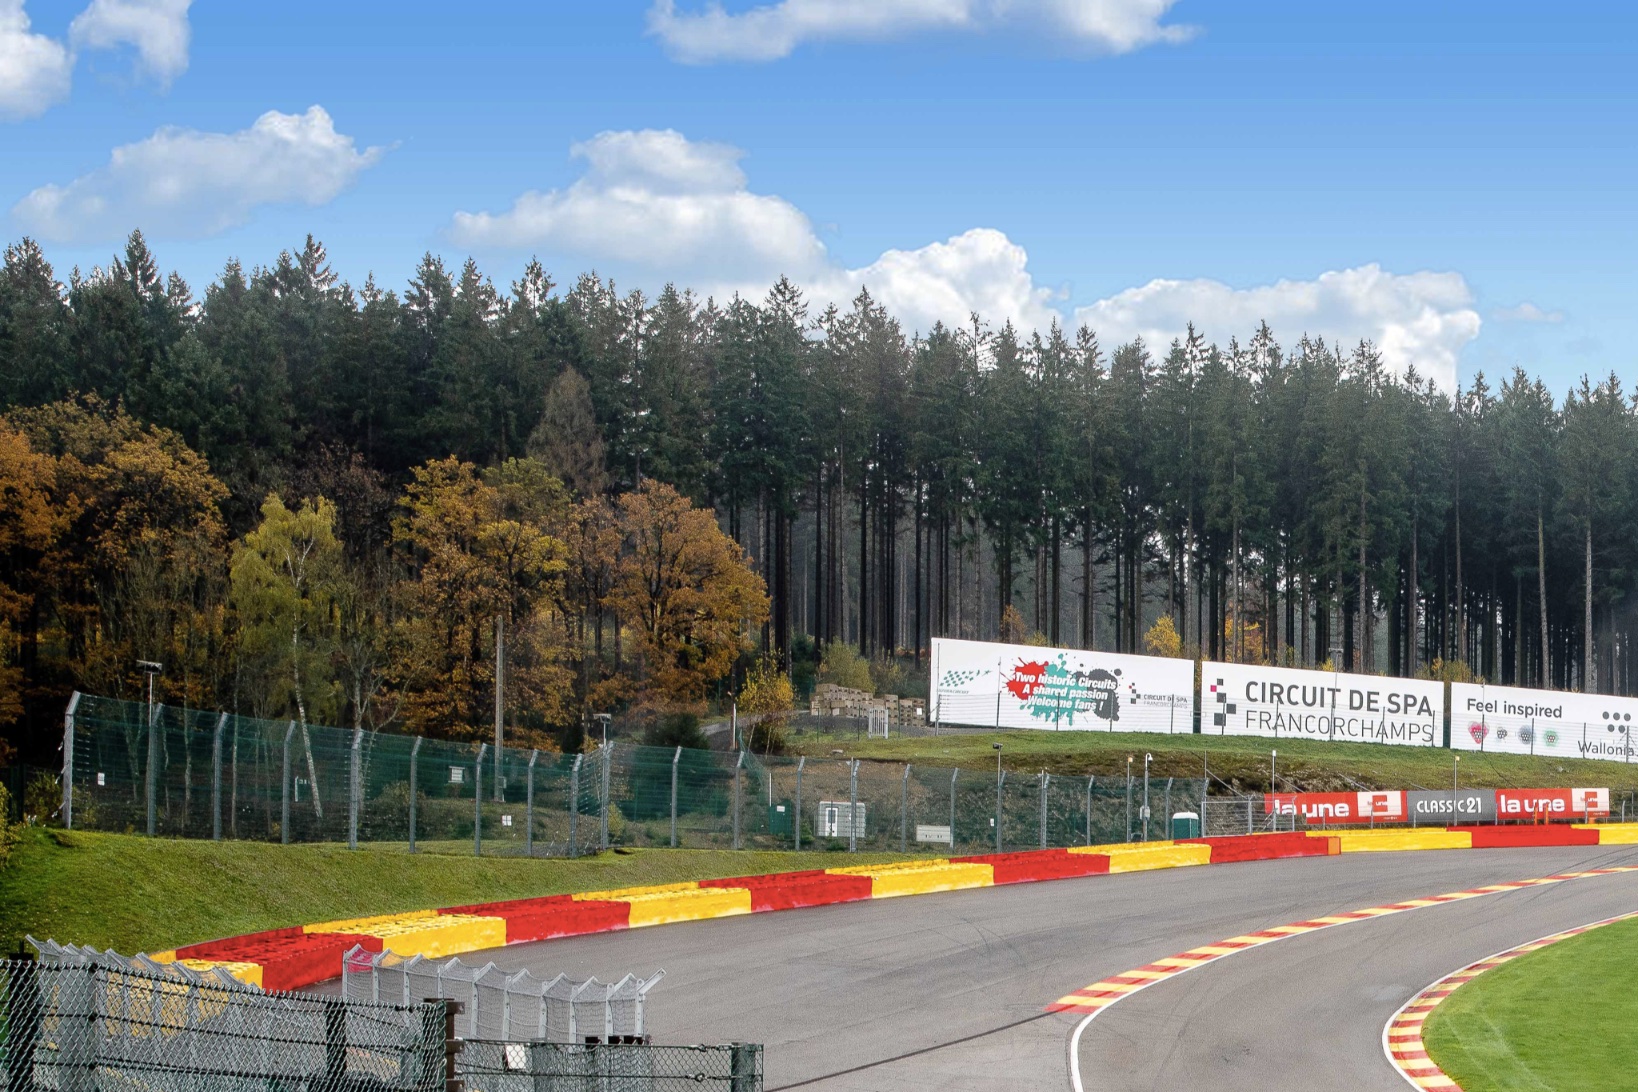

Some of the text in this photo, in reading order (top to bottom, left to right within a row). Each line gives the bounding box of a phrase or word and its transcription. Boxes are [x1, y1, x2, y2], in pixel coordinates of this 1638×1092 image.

[1016, 672, 1117, 690] Two historic Circuits
[1022, 684, 1108, 700] A shared passion
[1245, 681, 1433, 717] CIRCUIT DE SPA
[1028, 695, 1072, 708] Welcome
[1075, 700, 1097, 711] fans
[1467, 698, 1563, 719] Feel inspired
[1245, 710, 1434, 742] FRANCORCHAMPS
[1274, 799, 1350, 818] la une
[1416, 797, 1482, 814] CLASSIC 21
[1500, 794, 1565, 813] la une
